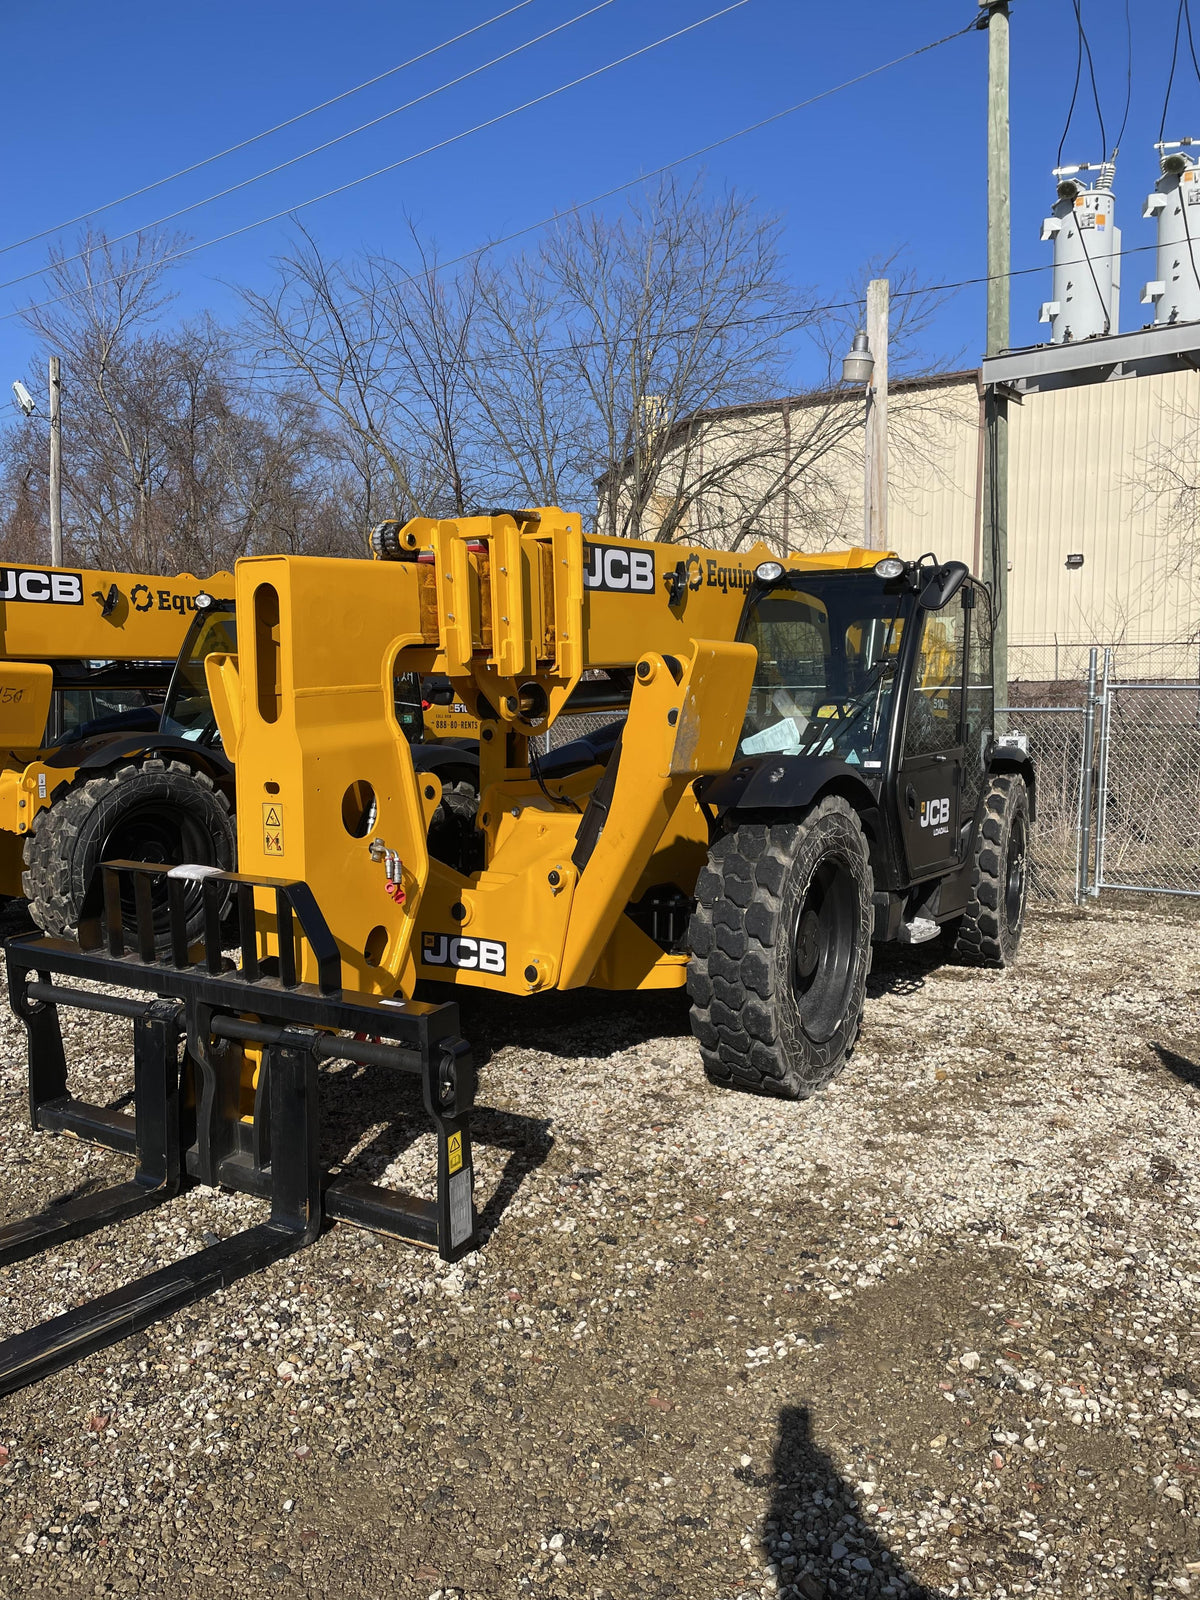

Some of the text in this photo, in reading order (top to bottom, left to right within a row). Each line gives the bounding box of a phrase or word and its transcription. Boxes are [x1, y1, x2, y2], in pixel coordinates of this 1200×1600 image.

[584, 547, 653, 590] JCB
[706, 559, 754, 594] Equip
[0, 570, 82, 603] JCB
[921, 798, 949, 827] JCB
[424, 936, 505, 973] JCB
